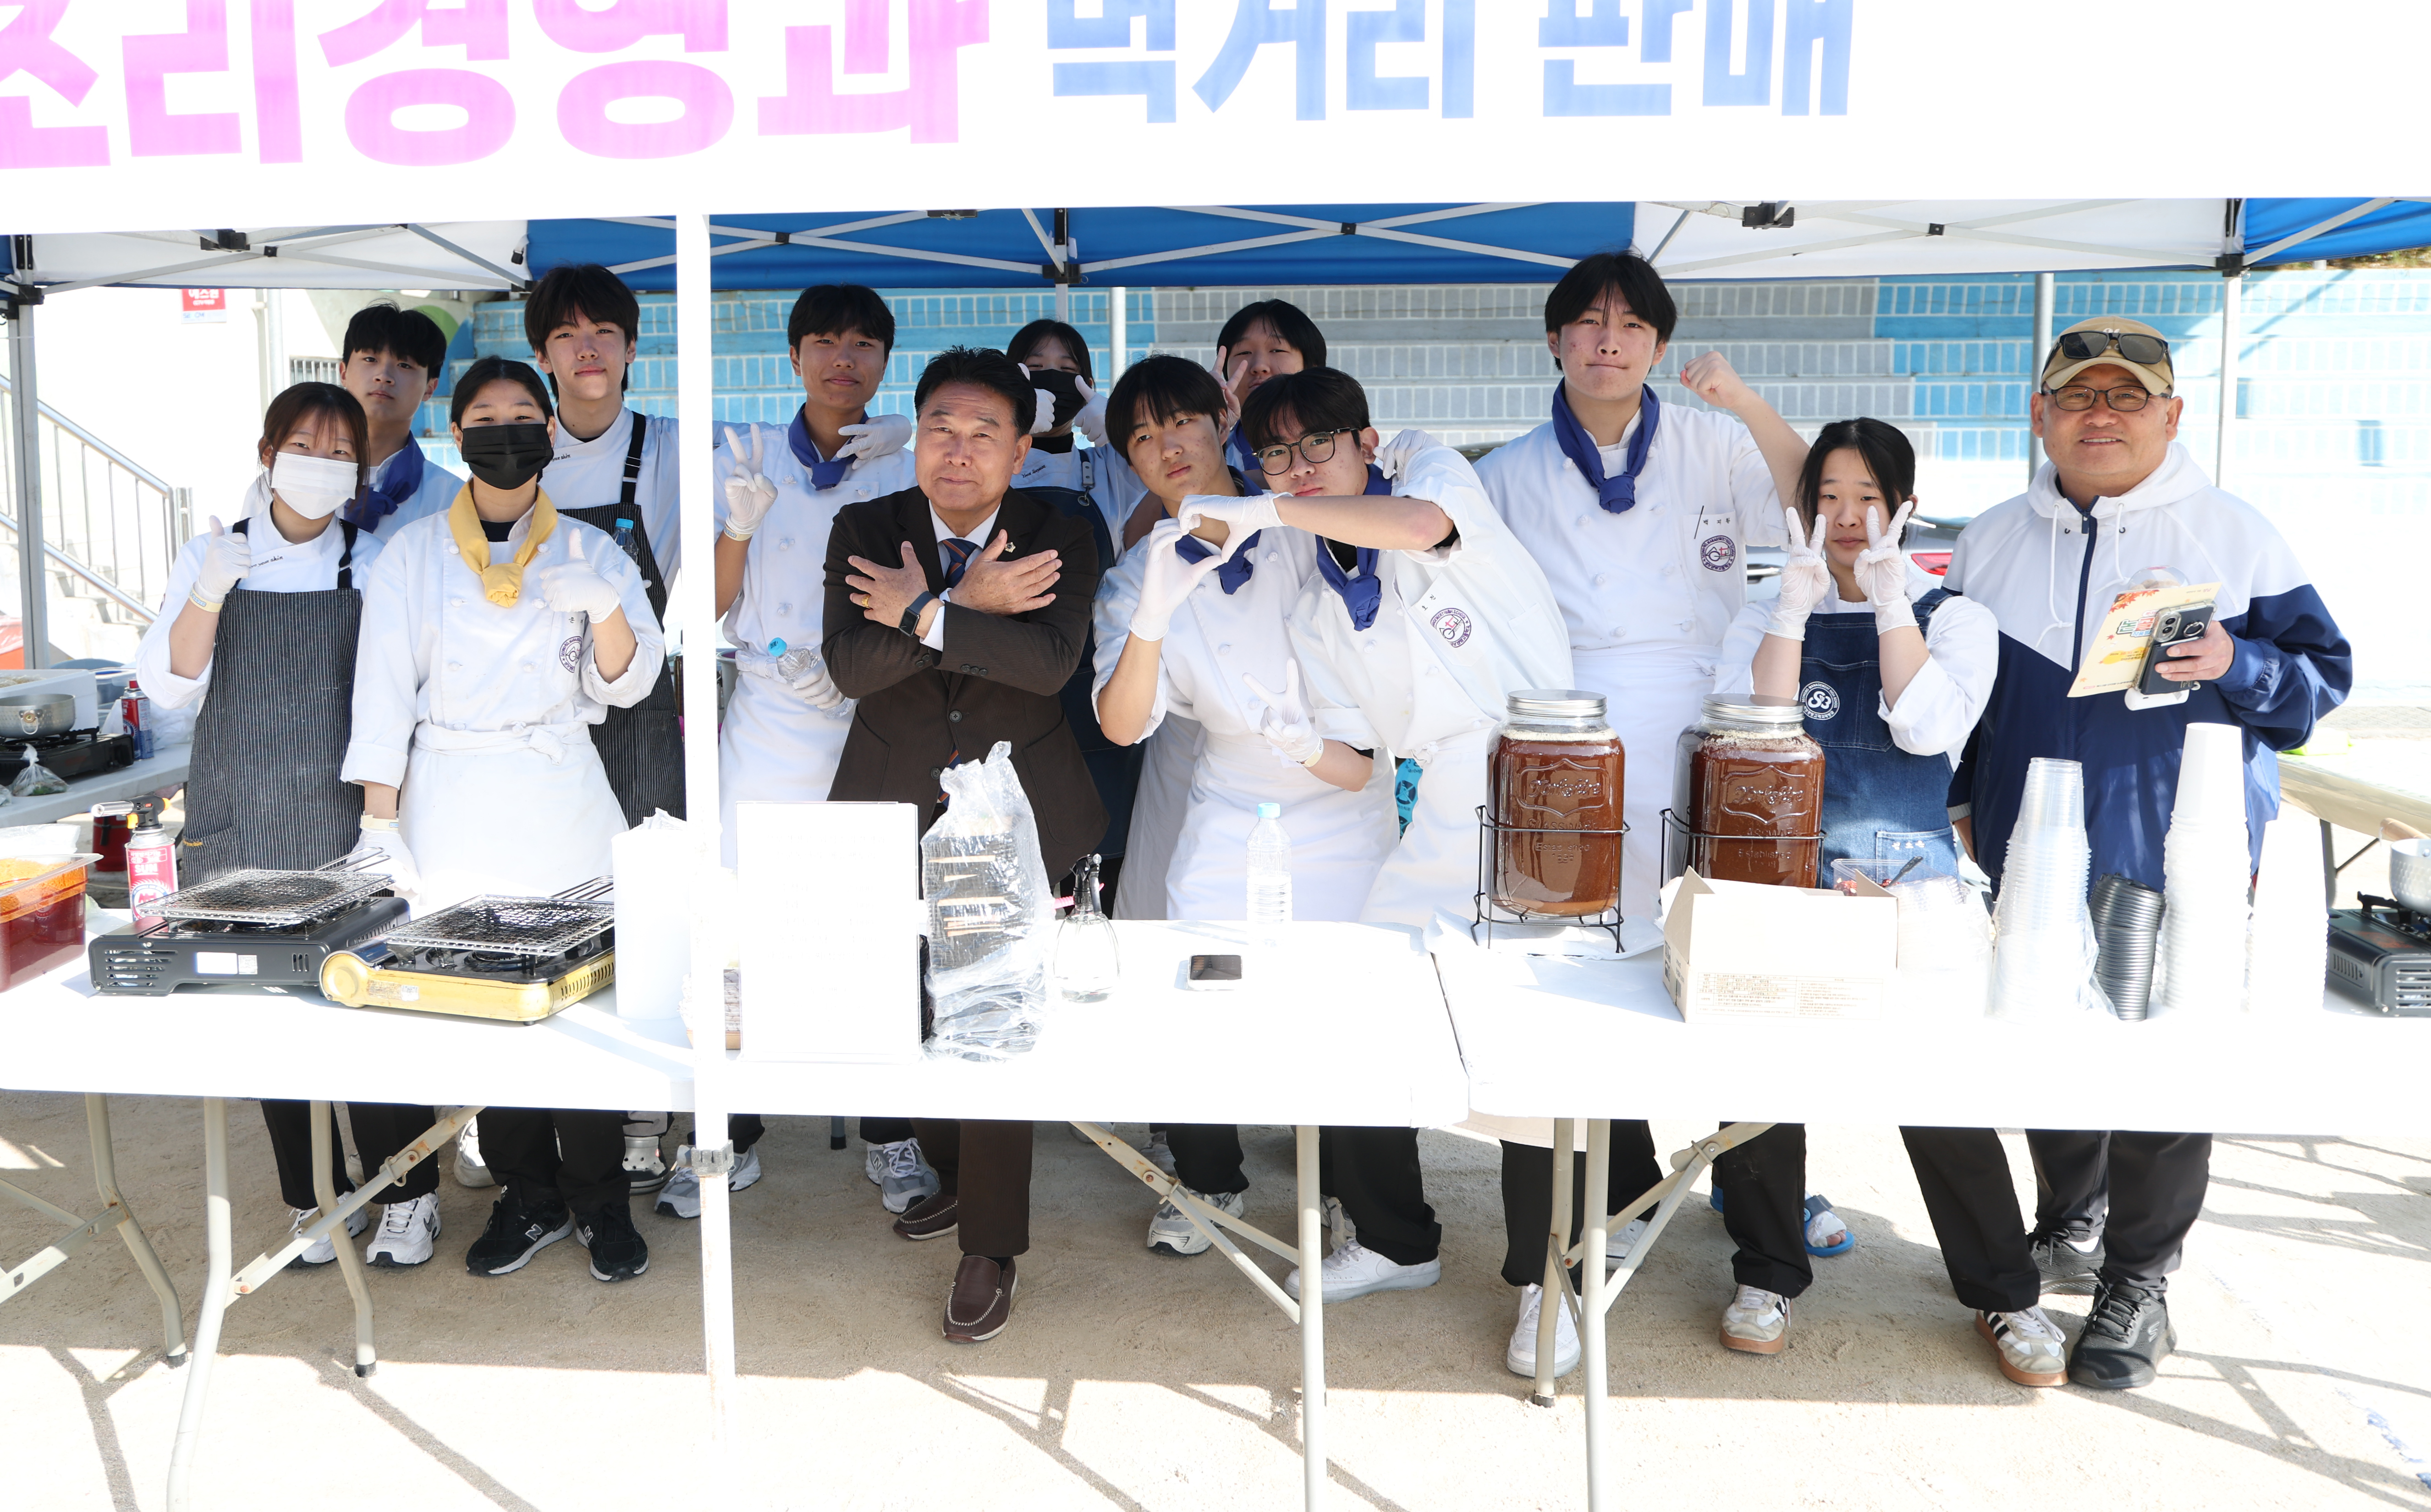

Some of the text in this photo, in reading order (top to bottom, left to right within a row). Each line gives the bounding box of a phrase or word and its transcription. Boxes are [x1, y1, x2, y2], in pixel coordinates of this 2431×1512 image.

[0, 0, 989, 168] 리경영과
[1528, 778, 1603, 799] Yorkshire
[134, 863, 159, 873] SUN
